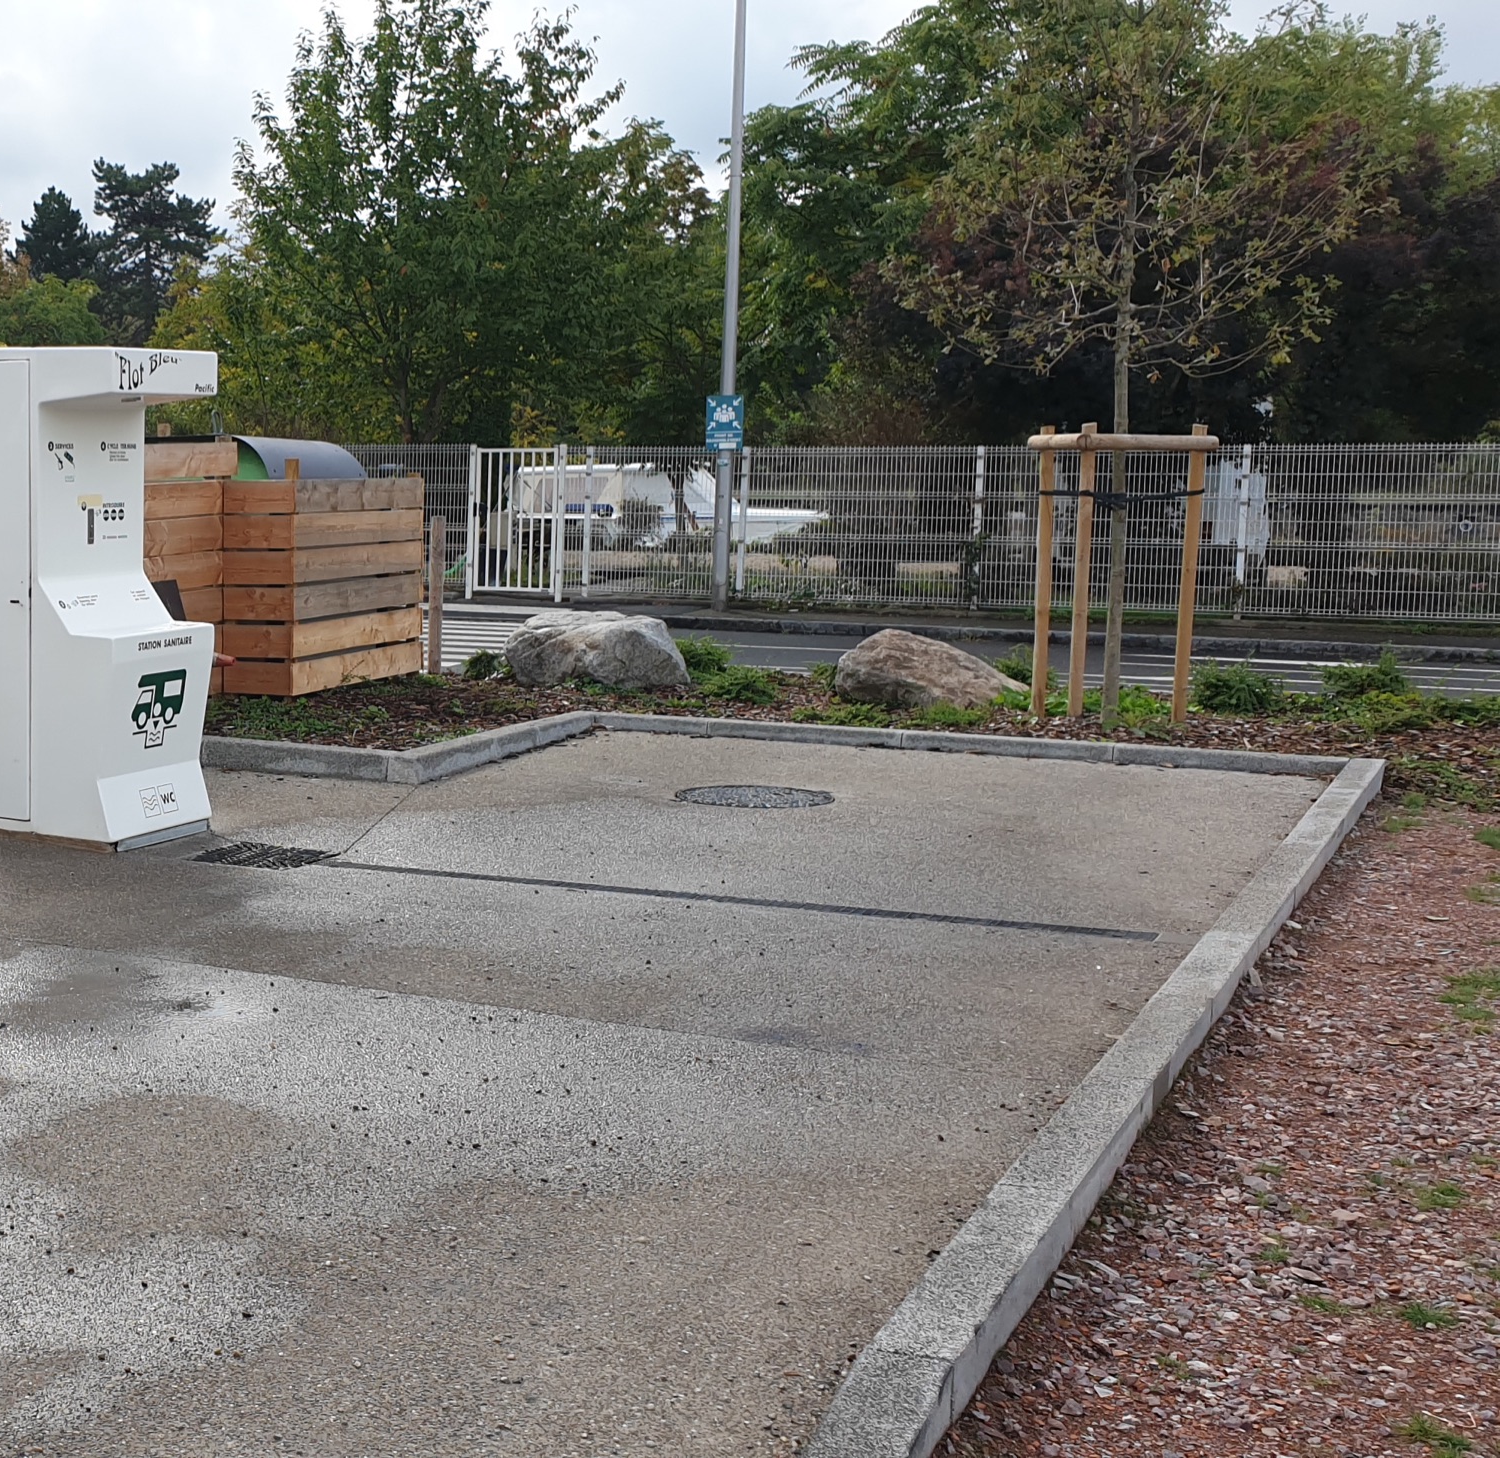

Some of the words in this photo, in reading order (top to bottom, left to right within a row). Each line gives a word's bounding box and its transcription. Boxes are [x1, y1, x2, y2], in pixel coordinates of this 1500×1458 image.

[195, 383, 215, 394] Pacific
[138, 640, 162, 651] STATION
[163, 635, 193, 648] SANITAIRE
[160, 791, 176, 804] WC
